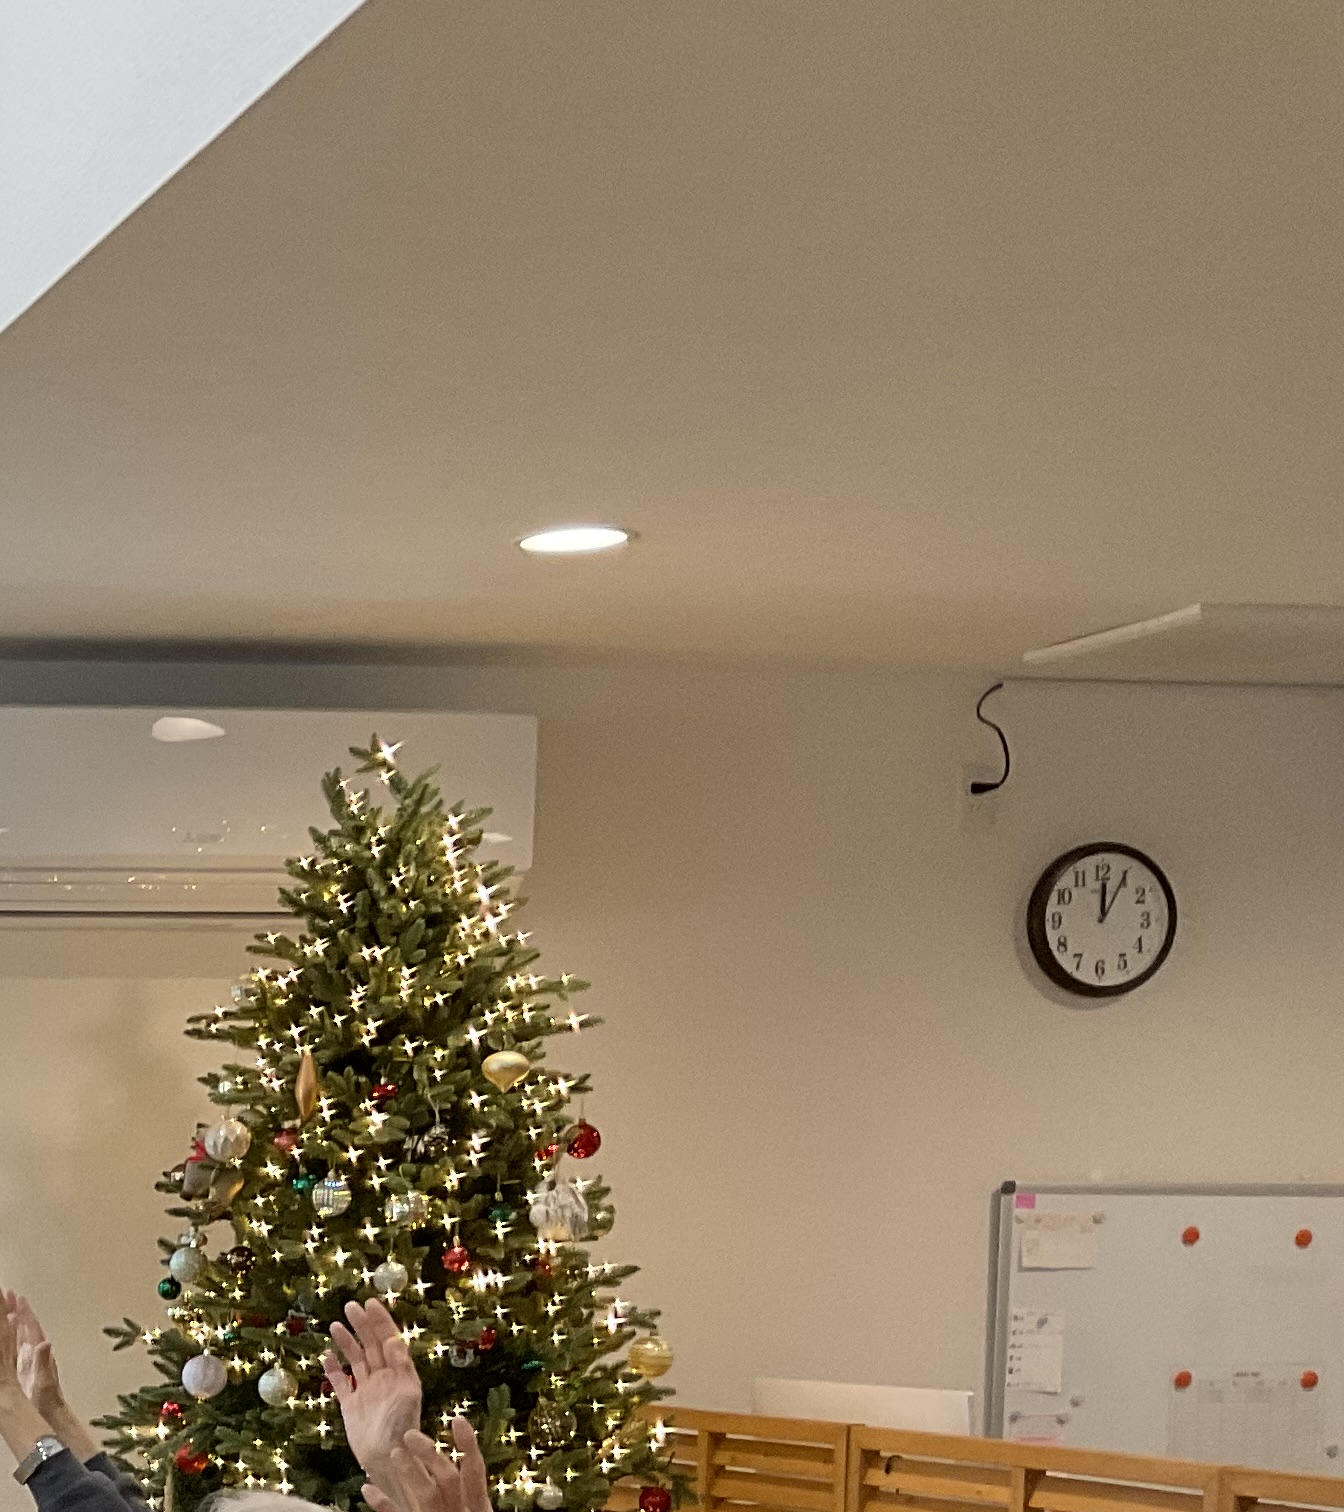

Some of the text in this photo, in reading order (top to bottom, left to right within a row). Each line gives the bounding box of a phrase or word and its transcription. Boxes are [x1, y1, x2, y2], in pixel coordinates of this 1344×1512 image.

[1074, 869, 1086, 888] 11
[1094, 863, 1111, 881] 12
[1056, 887, 1072, 906] 10
[1134, 887, 1146, 905] 2
[1051, 911, 1062, 930] 9
[1140, 911, 1151, 930] 3
[1056, 935, 1068, 953] 8
[1132, 934, 1143, 954] 4
[1073, 952, 1083, 971] 7
[1094, 959, 1105, 977] 6
[1117, 952, 1127, 971] 5
